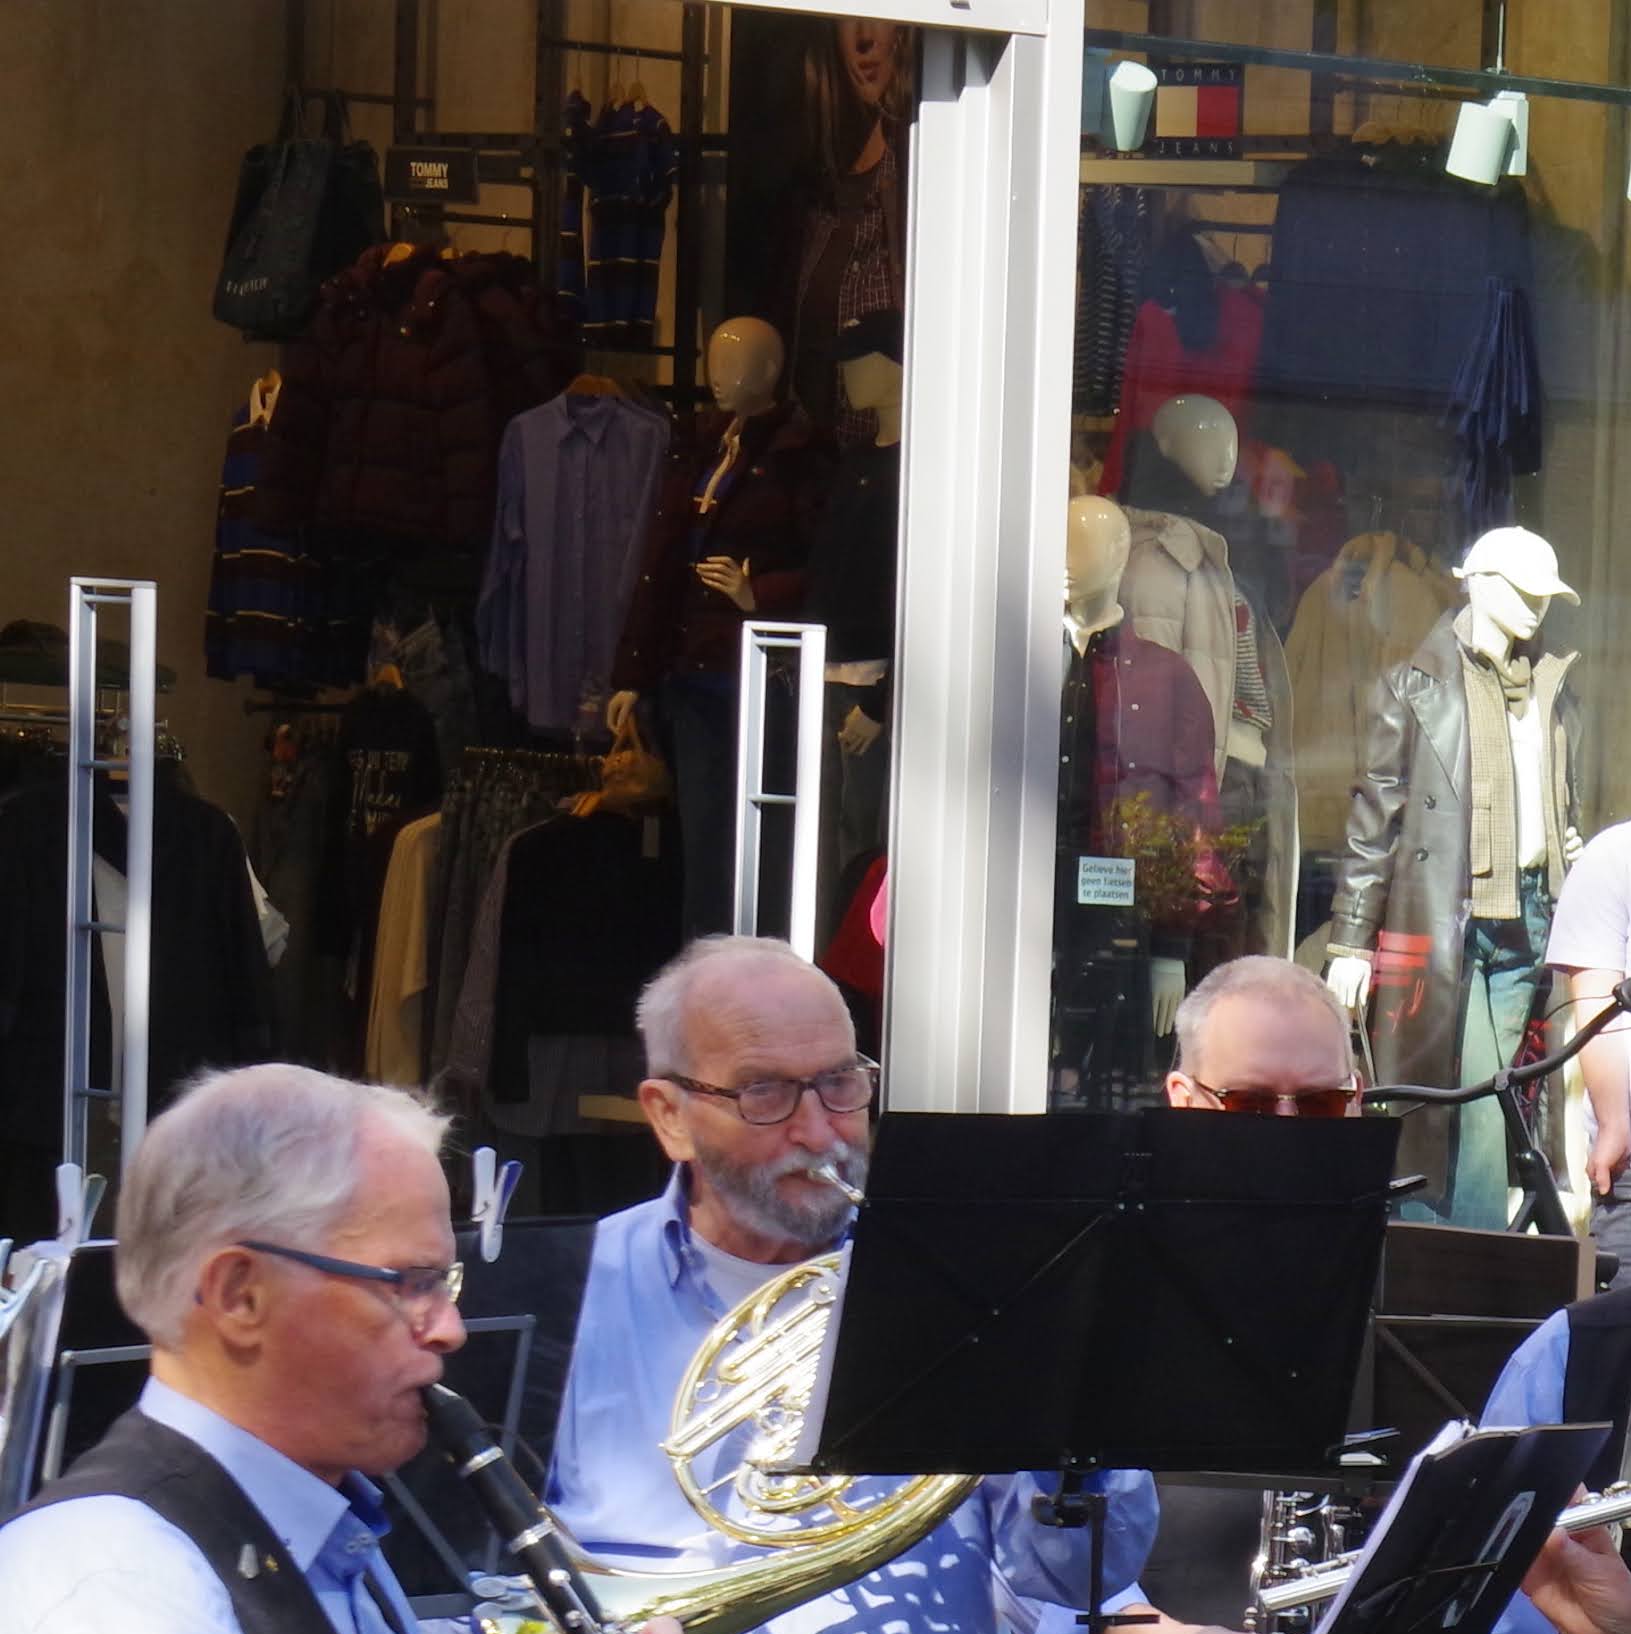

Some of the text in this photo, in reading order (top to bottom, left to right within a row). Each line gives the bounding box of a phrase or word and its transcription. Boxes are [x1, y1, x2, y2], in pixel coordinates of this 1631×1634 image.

[1160, 68, 1235, 82] TOMMY
[1159, 141, 1233, 154] JEANS
[410, 161, 449, 178] TOMMY
